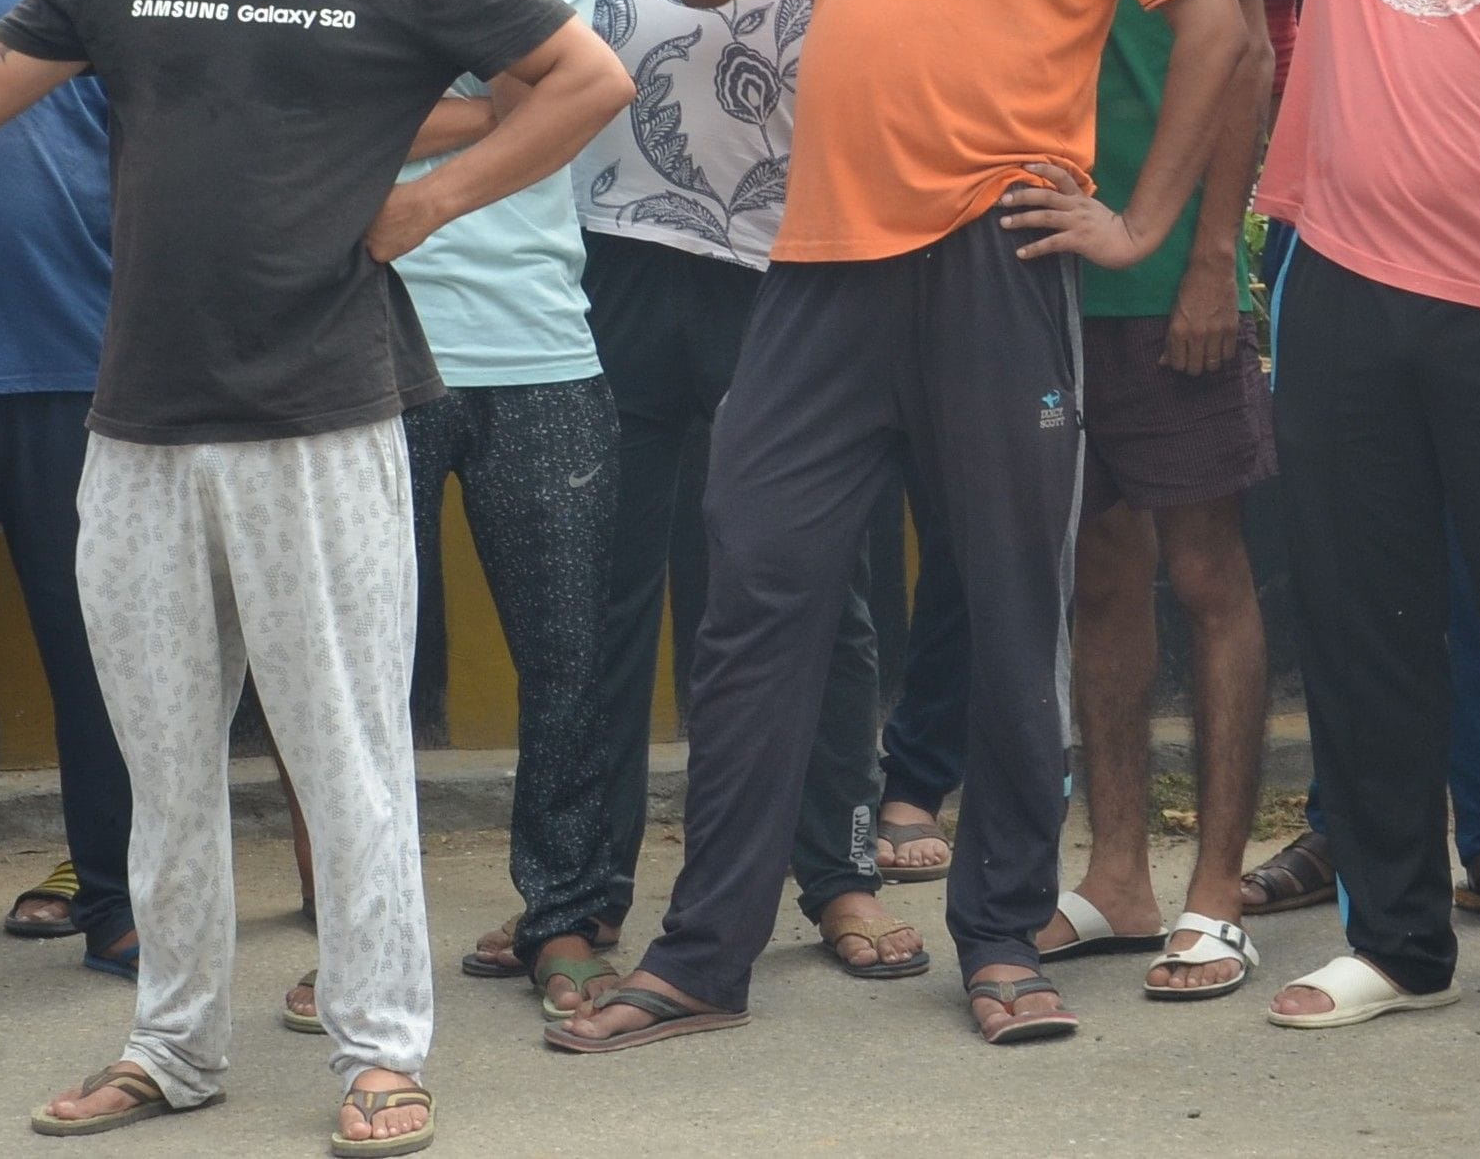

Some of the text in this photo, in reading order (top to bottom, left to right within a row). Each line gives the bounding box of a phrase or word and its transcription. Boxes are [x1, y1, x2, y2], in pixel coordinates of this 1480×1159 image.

[131, 0, 356, 29] SAMSUNG Galaxy S20
